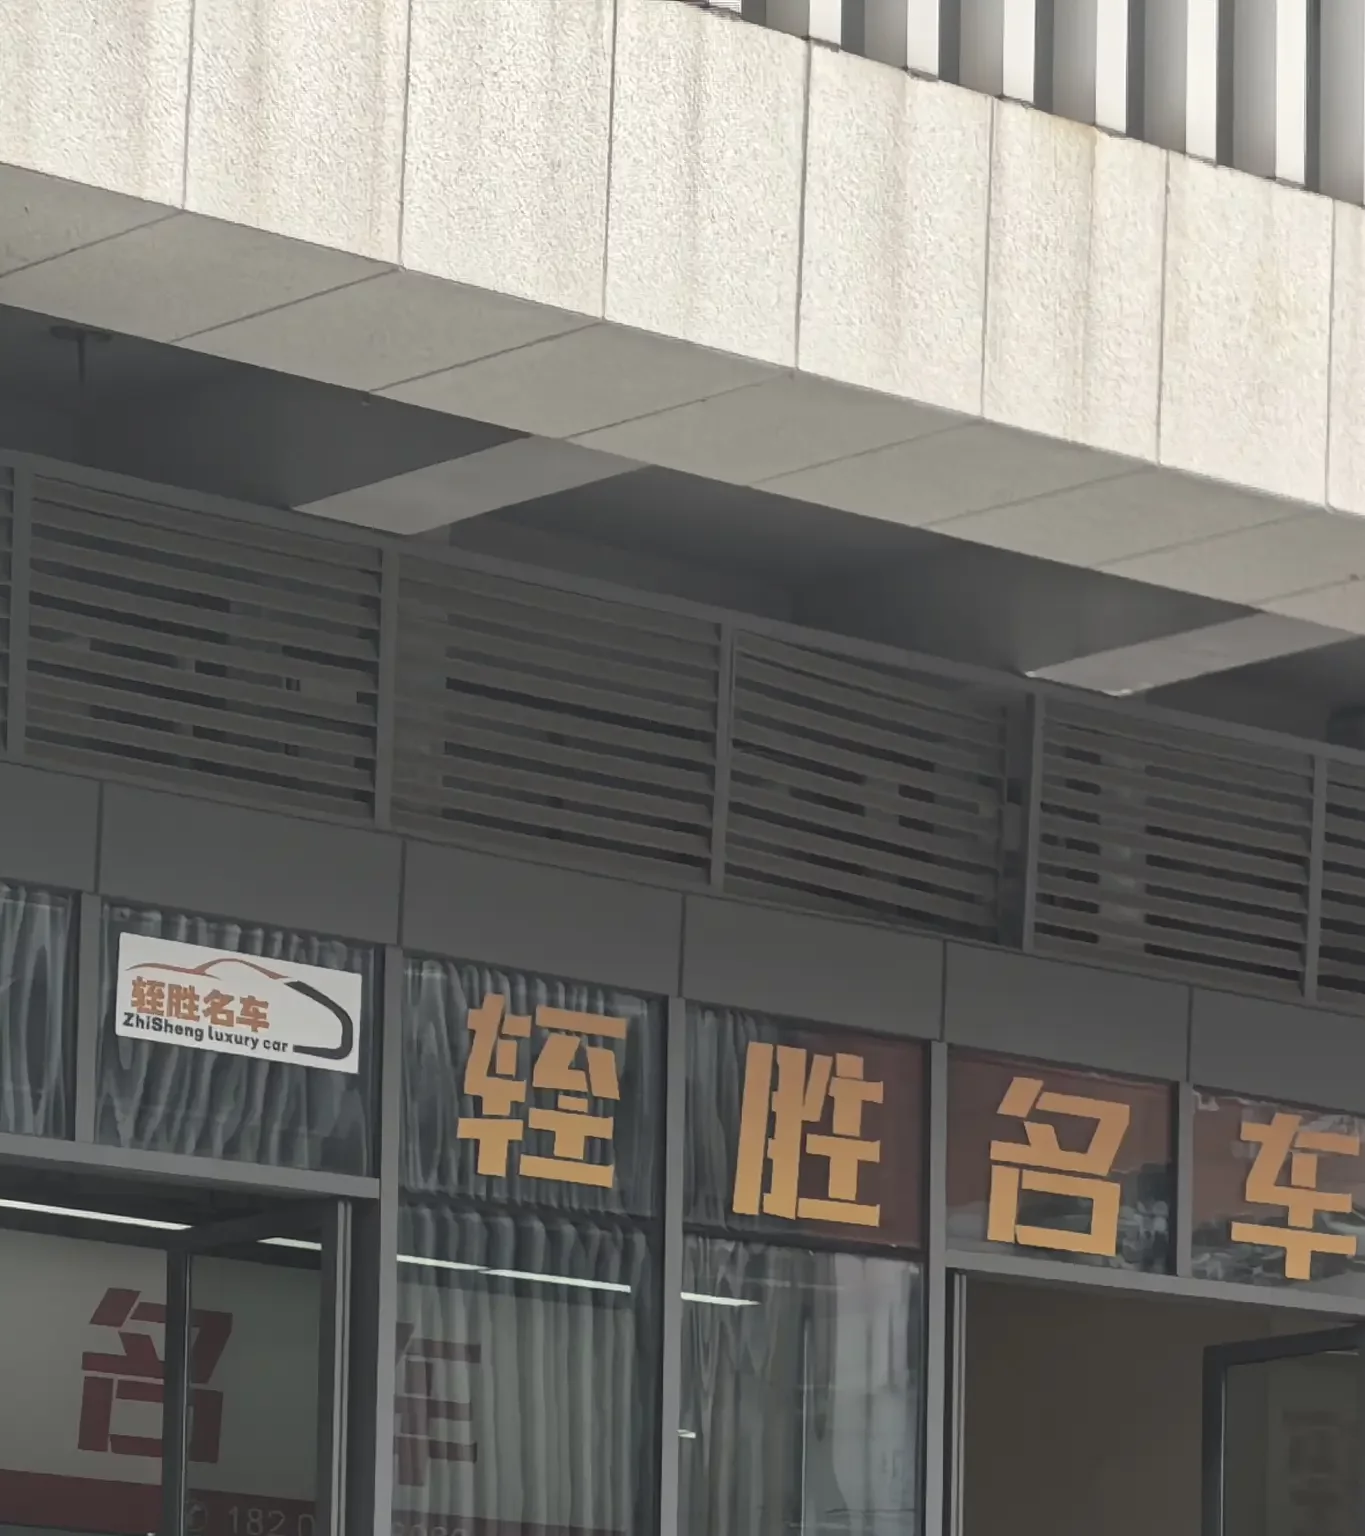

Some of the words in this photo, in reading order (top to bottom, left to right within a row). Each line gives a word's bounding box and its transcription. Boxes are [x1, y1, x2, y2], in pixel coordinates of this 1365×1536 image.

[122, 1011, 205, 1042] ZhiSheng
[207, 1028, 259, 1050] luxury
[263, 1037, 289, 1053] car
